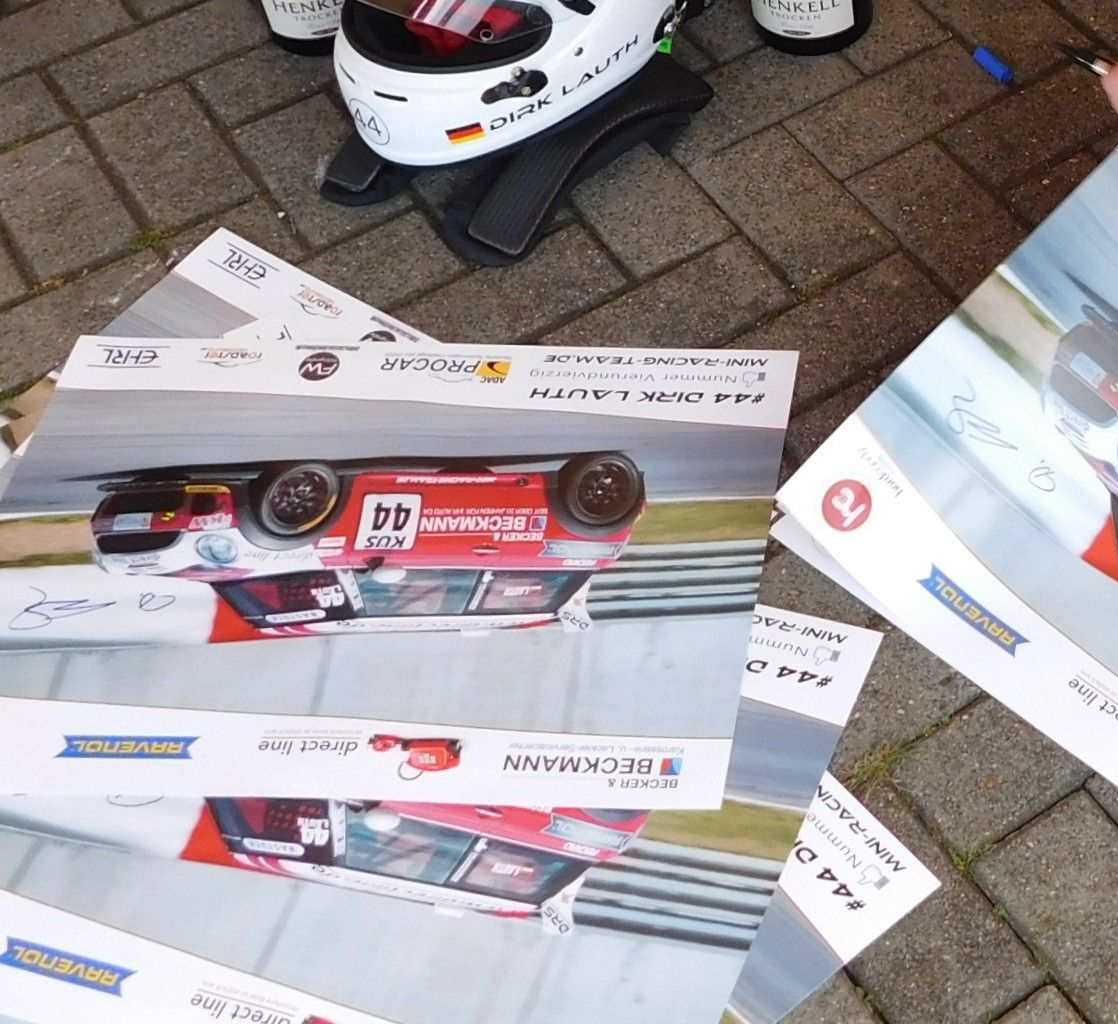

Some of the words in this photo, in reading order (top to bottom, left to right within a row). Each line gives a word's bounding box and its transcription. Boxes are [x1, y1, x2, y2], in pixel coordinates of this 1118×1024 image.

[293, 10, 343, 23] TROCKE
[770, 9, 823, 22] TROCKEN
[489, 96, 552, 132] DIRK
[561, 34, 640, 97] LAUTH
[354, 111, 383, 138] 44
[102, 348, 157, 364] EHRL
[544, 354, 768, 367] MINI-RACING-TEAM.DE
[380, 358, 481, 371] PROCAR
[529, 369, 655, 383] Vierundvierzig
[661, 374, 737, 384] Nummer
[529, 388, 630, 401] LAUTH
[637, 390, 703, 403] DIRK
[714, 392, 766, 404] #44
[371, 502, 411, 530] 44
[418, 516, 526, 530] BECKMANN
[493, 532, 501, 540] &
[504, 532, 543, 540] BECKER
[929, 575, 1015, 645] RAVENOL
[751, 614, 847, 644] MINI-RAC
[748, 635, 808, 656] Numm
[776, 664, 832, 688] #44
[1066, 676, 1098, 705] line
[70, 736, 193, 758] RAVENOL
[258, 740, 292, 755] line
[300, 740, 357, 754] direct
[503, 754, 652, 773] BECKMANN
[620, 778, 677, 787] BECKER
[818, 784, 906, 871] MINI-RACIN
[806, 811, 862, 868] Numme
[815, 865, 866, 911] #44
[11, 947, 116, 984] RAVENOL
[190, 993, 227, 1019] line
